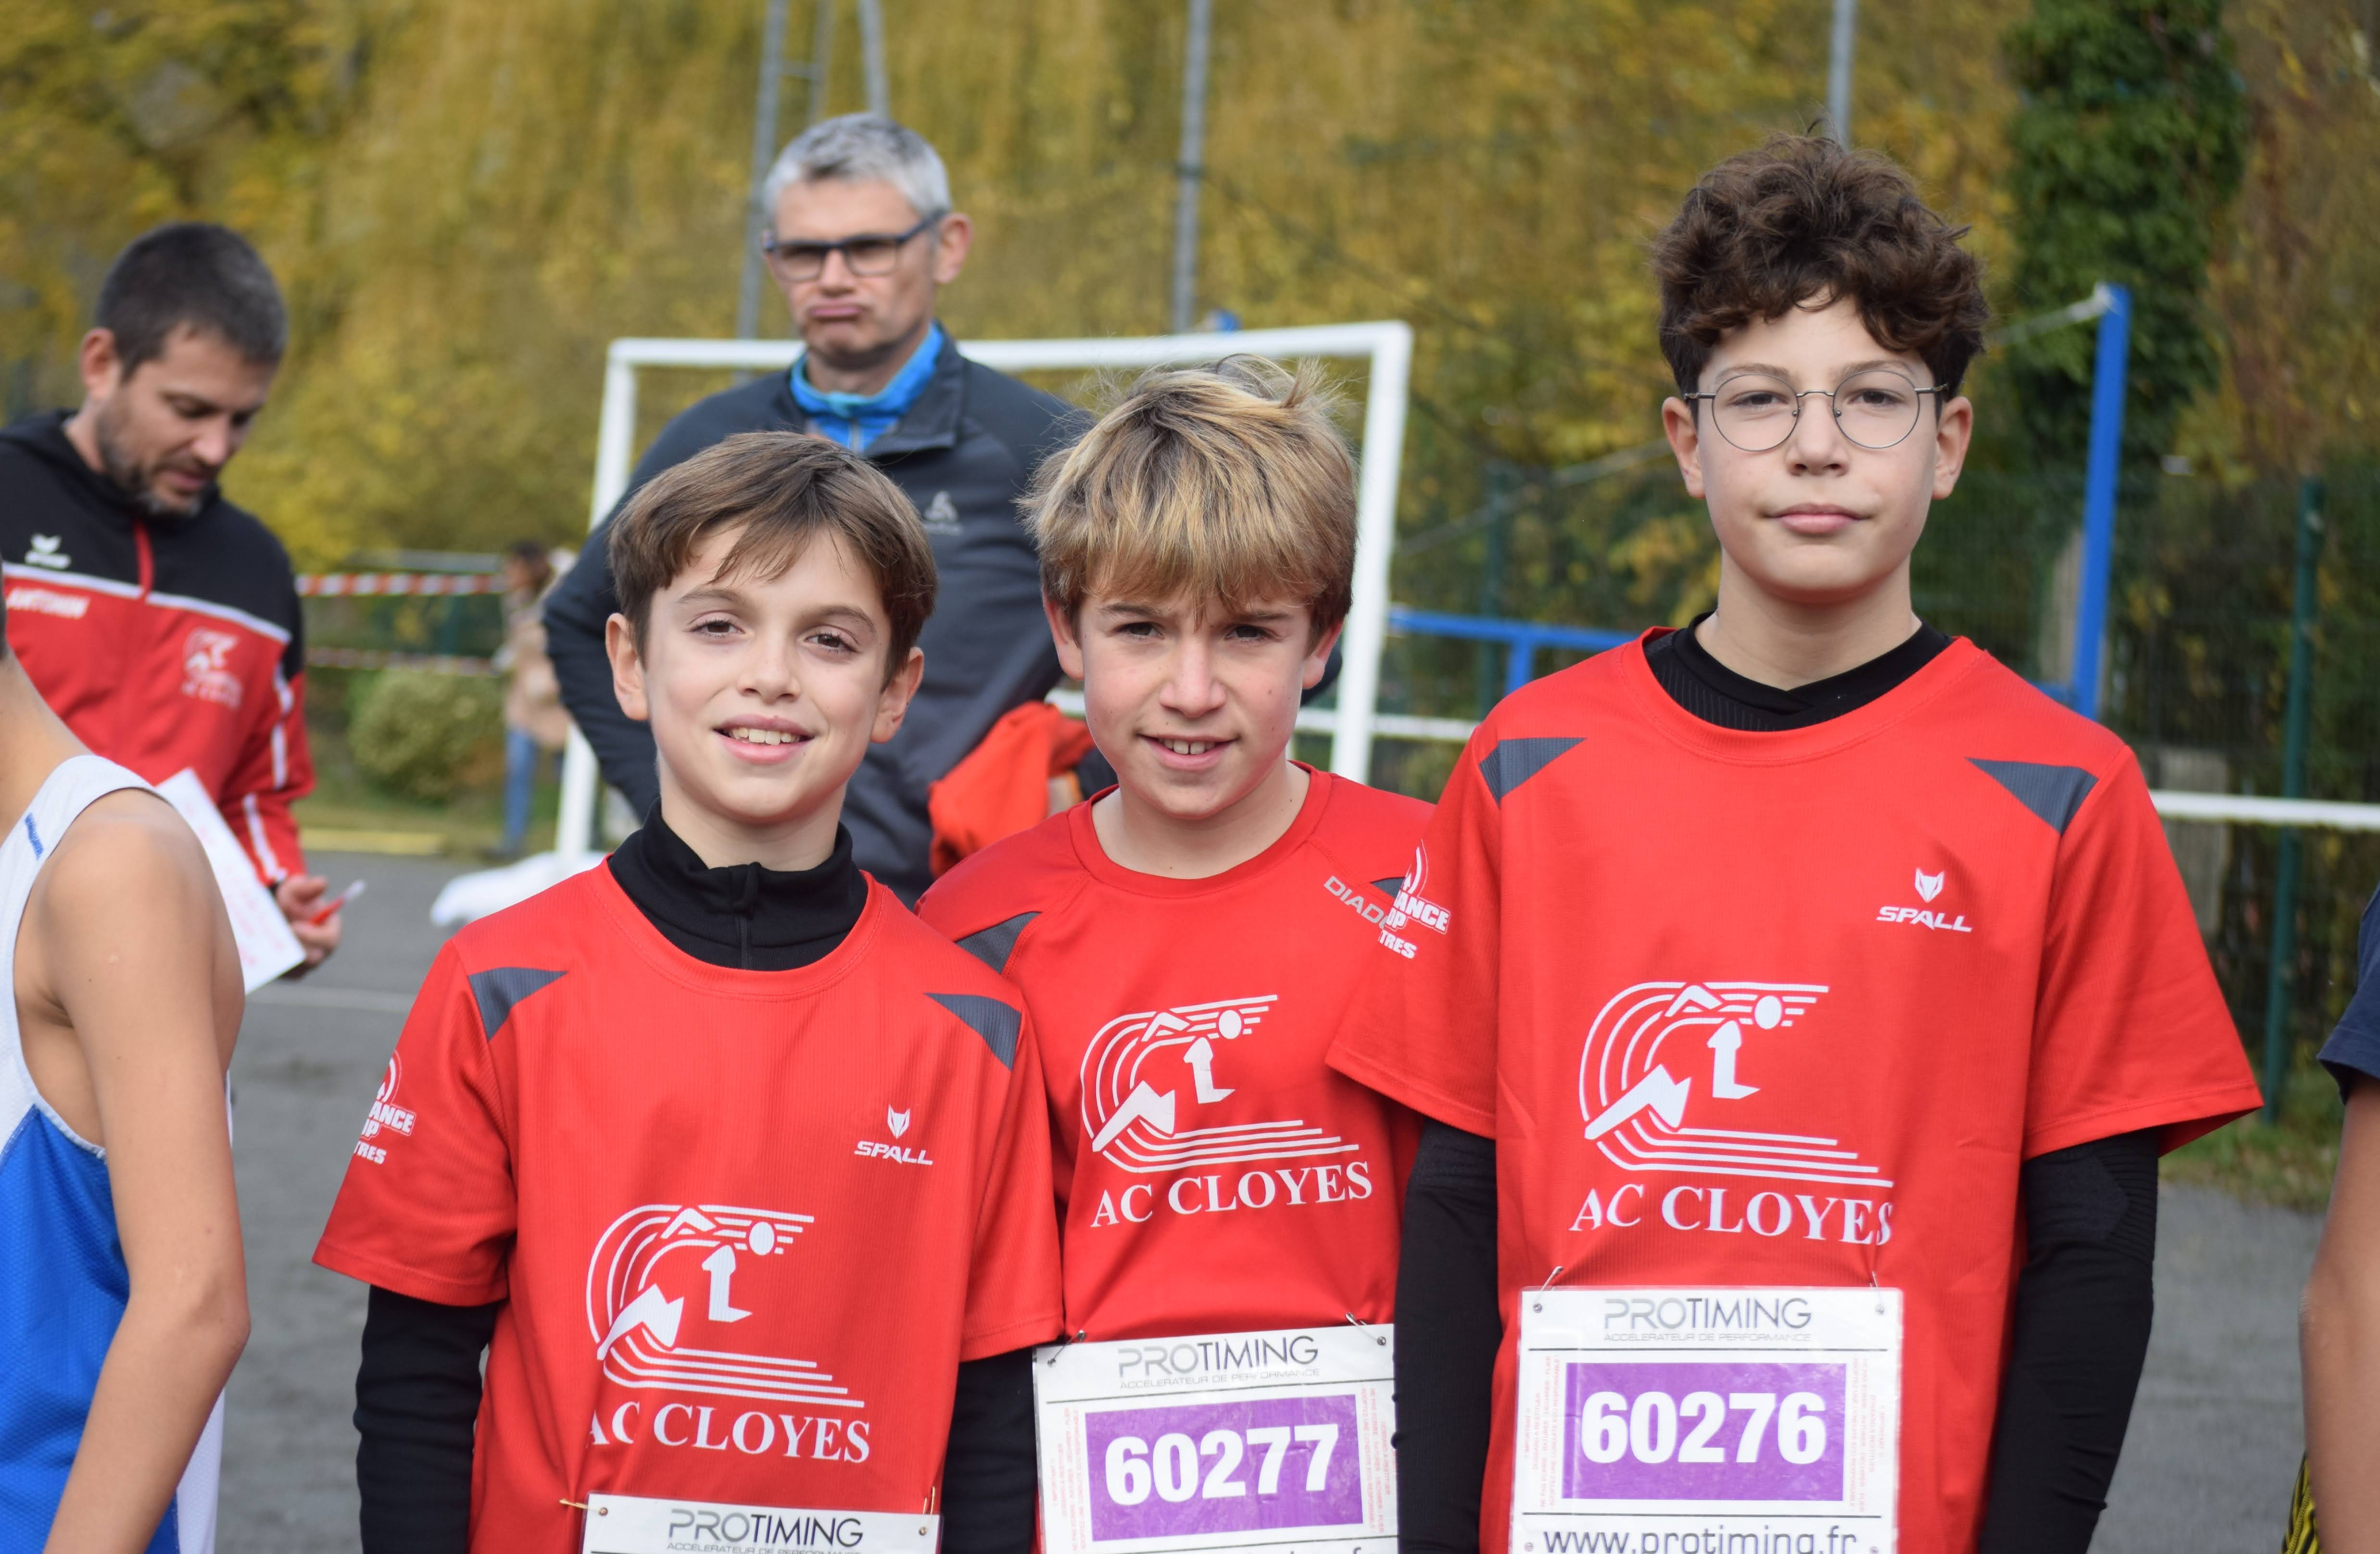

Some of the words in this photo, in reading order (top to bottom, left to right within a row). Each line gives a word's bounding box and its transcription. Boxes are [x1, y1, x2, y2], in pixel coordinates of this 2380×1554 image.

[1876, 906, 1973, 932] SPALL
[854, 1140, 933, 1165] SPALL
[1090, 1184, 1153, 1228] AC
[1169, 1161, 1372, 1214] CLOYES
[1568, 1185, 1644, 1232] AC
[1662, 1186, 1894, 1246] CLOYES
[1604, 1298, 1812, 1329] PROTIMING
[1118, 1336, 1319, 1377] PROTIMING
[654, 1404, 870, 1463] CLOYES
[1581, 1391, 1826, 1464] 60276
[1105, 1424, 1338, 1505] 60277
[668, 1508, 863, 1548] PROTIMING
